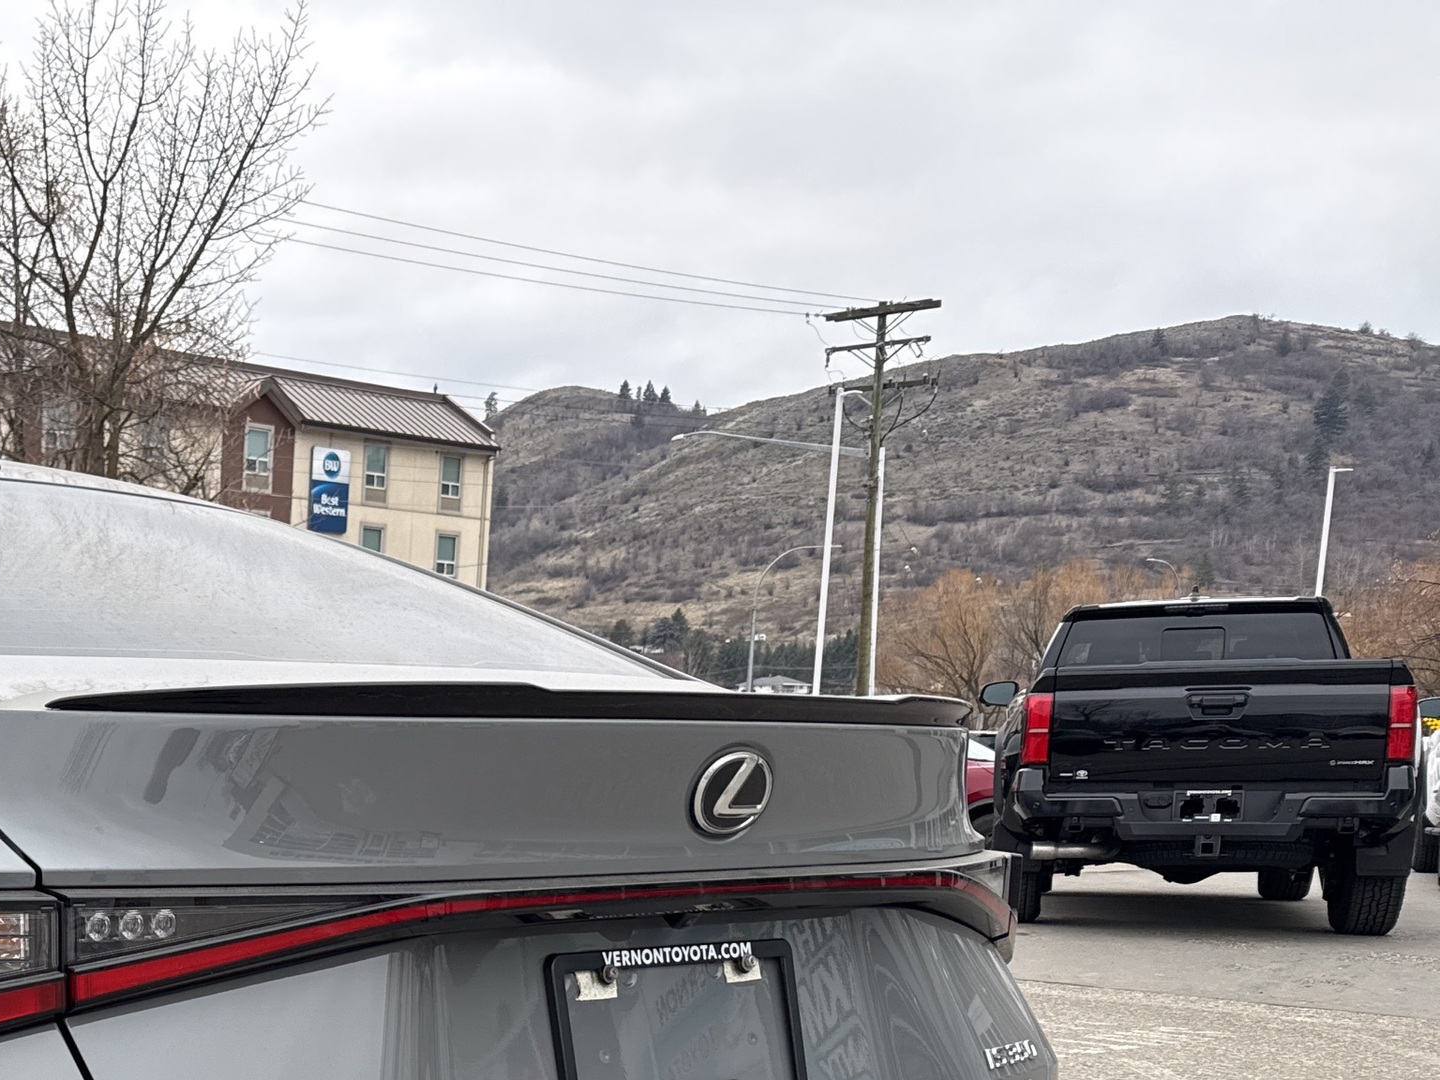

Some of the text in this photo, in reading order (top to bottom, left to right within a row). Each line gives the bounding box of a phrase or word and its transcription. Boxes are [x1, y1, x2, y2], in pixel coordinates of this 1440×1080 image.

[321, 494, 339, 505] Best
[1104, 738, 1331, 750] TACOMA
[602, 942, 752, 966] VERNONTOYOTA.COM
